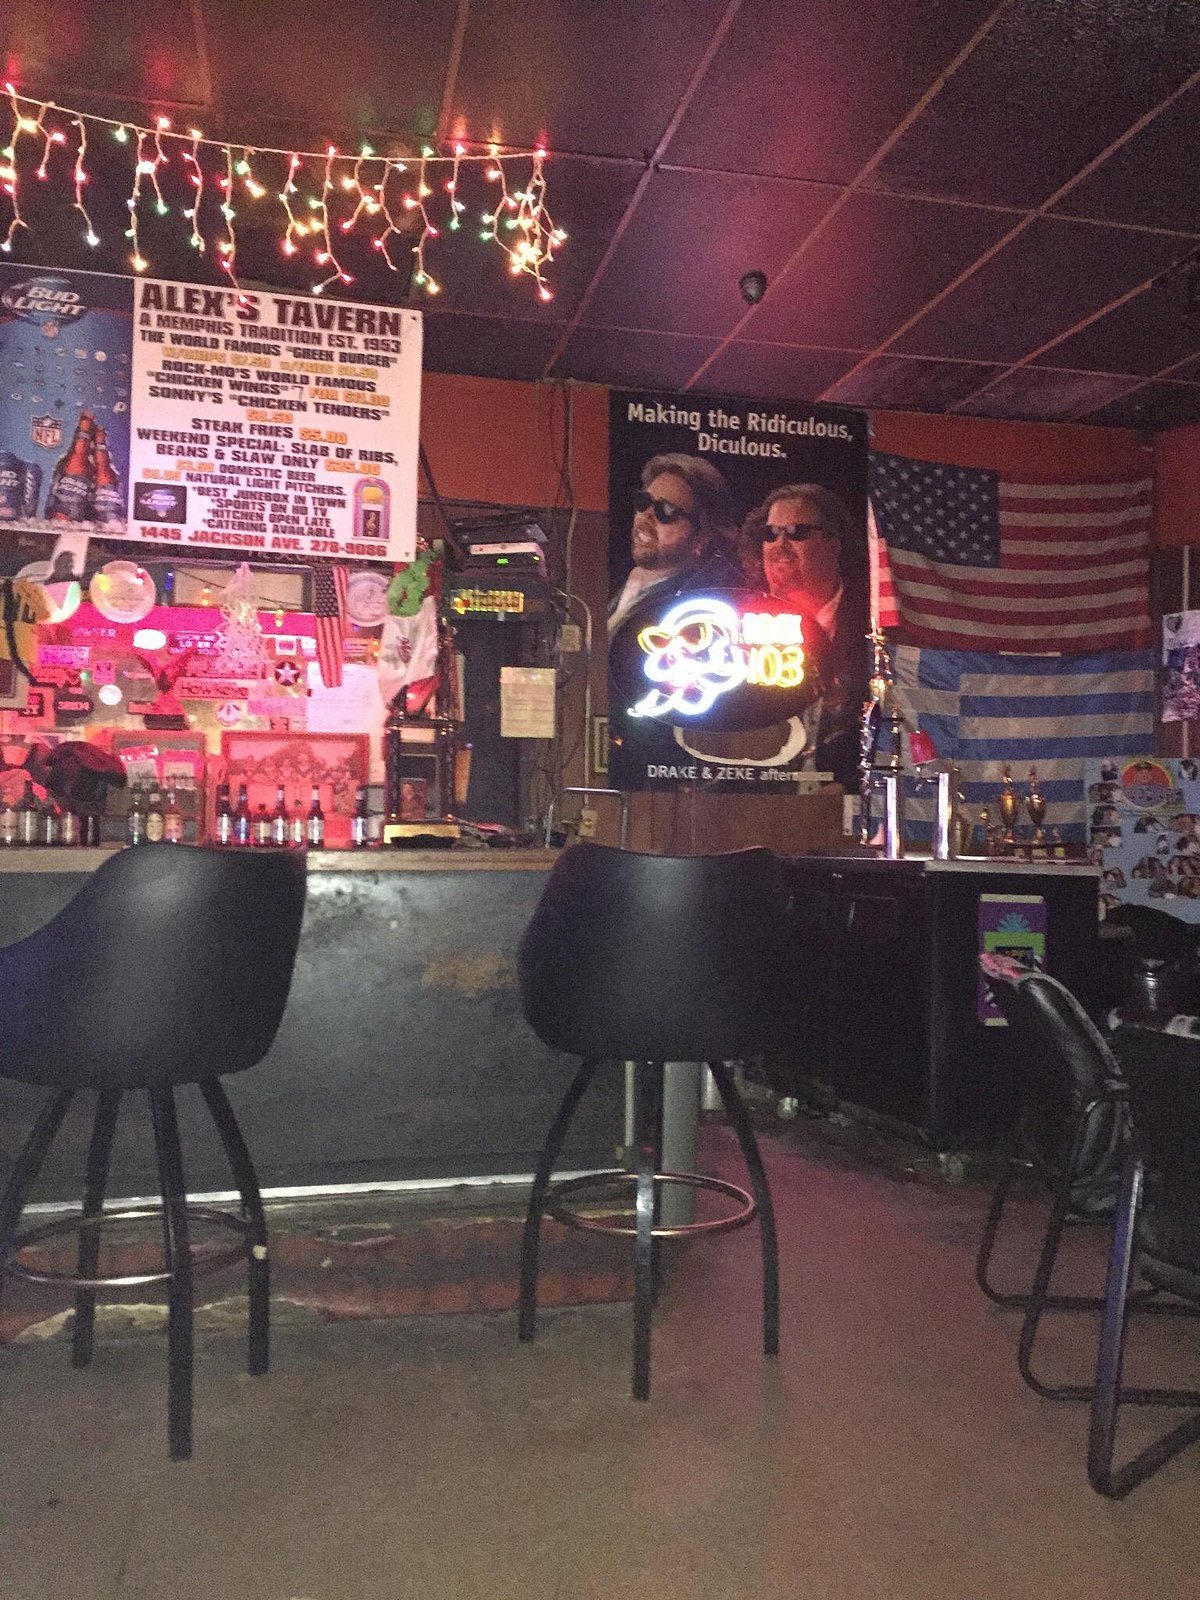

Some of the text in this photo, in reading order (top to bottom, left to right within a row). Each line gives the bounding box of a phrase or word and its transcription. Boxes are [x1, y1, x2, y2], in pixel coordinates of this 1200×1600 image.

[14, 297, 88, 315] LIGHT
[26, 286, 80, 303] BUD
[140, 283, 402, 337] ALEX'S TAVERN
[139, 312, 401, 354] A MEMPHIS TRADITION EST. 1953
[140, 329, 398, 368] THE WORLD FAMOUS "GREEK BURGER"
[146, 371, 223, 389] "CHICKEN
[228, 379, 289, 395] WINGS"
[161, 360, 376, 392] ROCK-MO'S WORLD FAMOUS
[148, 385, 390, 420] SONNY'S "CHICKEN TENDERS"
[191, 418, 243, 434] STEAK
[249, 424, 293, 438] FRIES
[627, 403, 853, 442] Making the Ridiculous,
[136, 428, 399, 466] WEEKEND SPECIAL: SLAB OF RIBS,
[156, 443, 208, 458] BEANS
[214, 449, 225, 460] &
[231, 450, 276, 464] SLAW
[282, 455, 318, 469] ONLY
[697, 432, 788, 459] Diculous.
[185, 472, 241, 486] NATURAL
[246, 478, 280, 490] LIGHT
[285, 481, 347, 496] PITCHERS.
[219, 464, 282, 479] DOMESTIC
[287, 470, 316, 481] BEER
[233, 490, 289, 503] JUKEBOX
[294, 495, 306, 505] IN
[311, 497, 346, 508] TOWN
[270, 503, 287, 513] ON
[292, 505, 308, 515] HD
[313, 507, 328, 517] TV
[269, 513, 300, 525] OPEN
[305, 517, 332, 528] LATE
[272, 524, 335, 538] AVAILABLE
[140, 526, 181, 541] 1445
[188, 531, 265, 547] JACKSON
[271, 537, 304, 550] AVE.
[747, 645, 805, 688] 103
[647, 765, 698, 780] DRAKE
[701, 766, 713, 780] &
[716, 767, 755, 781] ZEKE
